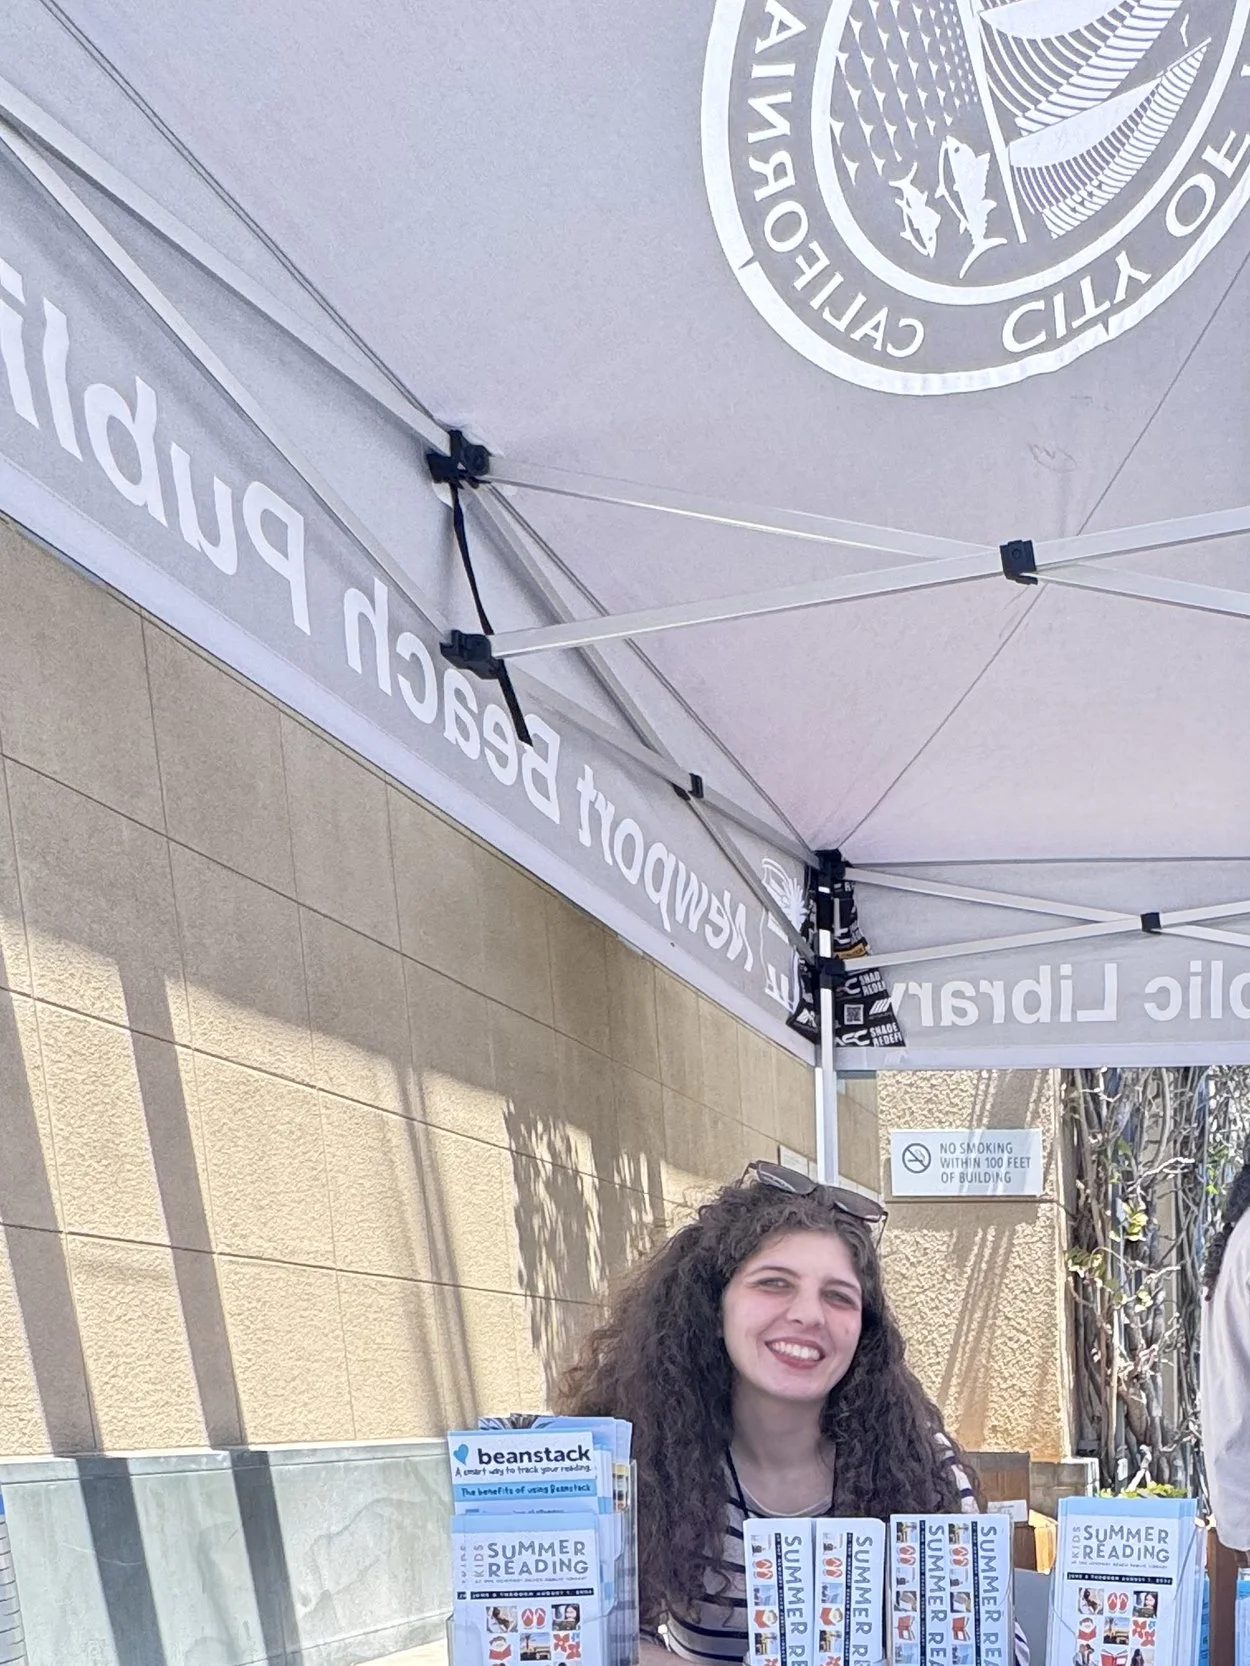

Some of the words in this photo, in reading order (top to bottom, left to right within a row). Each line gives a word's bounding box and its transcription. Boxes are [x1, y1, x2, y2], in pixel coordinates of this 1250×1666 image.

[940, 1143, 956, 1154] NO
[960, 1143, 1013, 1154] SMOKING
[940, 1157, 980, 1168] WITHIN
[985, 1157, 1003, 1168] 100
[1007, 1157, 1031, 1168] FEET
[941, 1172, 955, 1183] OF
[959, 1172, 1011, 1183] BUILDING
[478, 1445, 591, 1465] beanstack
[455, 1467, 462, 1477] A
[506, 1466, 515, 1474] to
[518, 1465, 538, 1473] track
[462, 1488, 475, 1497] The
[478, 1487, 513, 1495] benefits
[515, 1486, 525, 1494] of
[527, 1486, 548, 1494] using
[550, 1484, 591, 1494] Beanstack
[1083, 1524, 1169, 1545] SUMMER
[488, 1539, 586, 1560] SUMMER
[1083, 1543, 1170, 1563] READING
[488, 1558, 589, 1577] READING
[927, 1525, 947, 1623] SUMMER
[979, 1526, 1001, 1623] SUMMER
[784, 1535, 807, 1635] SUMMER
[852, 1536, 872, 1635] SUMMER
